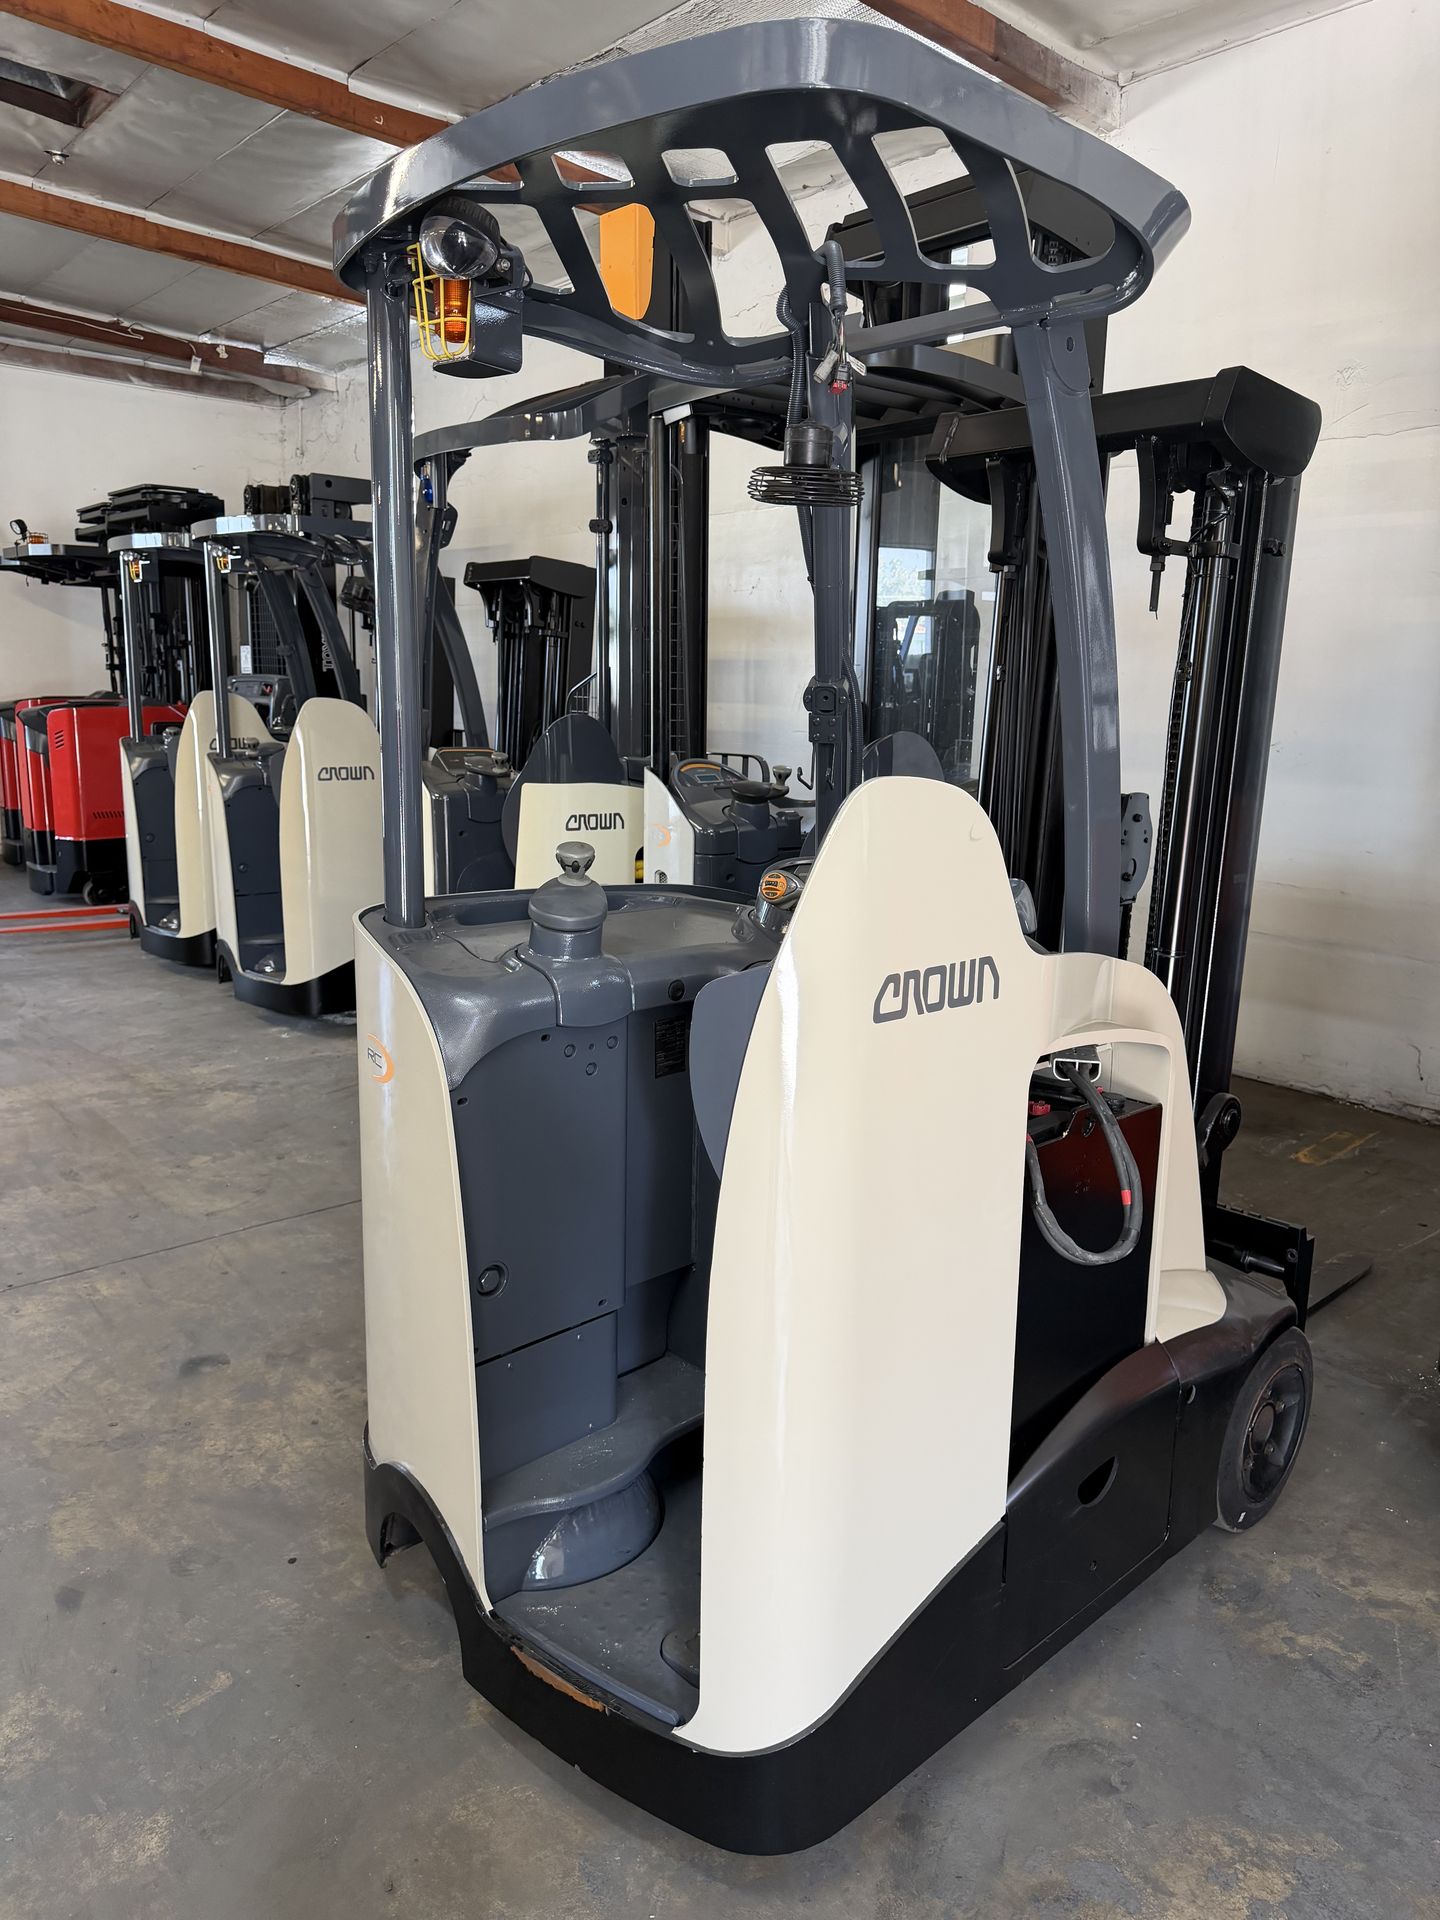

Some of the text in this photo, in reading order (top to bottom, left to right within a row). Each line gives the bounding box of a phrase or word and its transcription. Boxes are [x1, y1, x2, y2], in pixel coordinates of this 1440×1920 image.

[318, 766, 374, 781] CROWN
[565, 812, 625, 831] CROWN
[873, 956, 1000, 1024] CROWN
